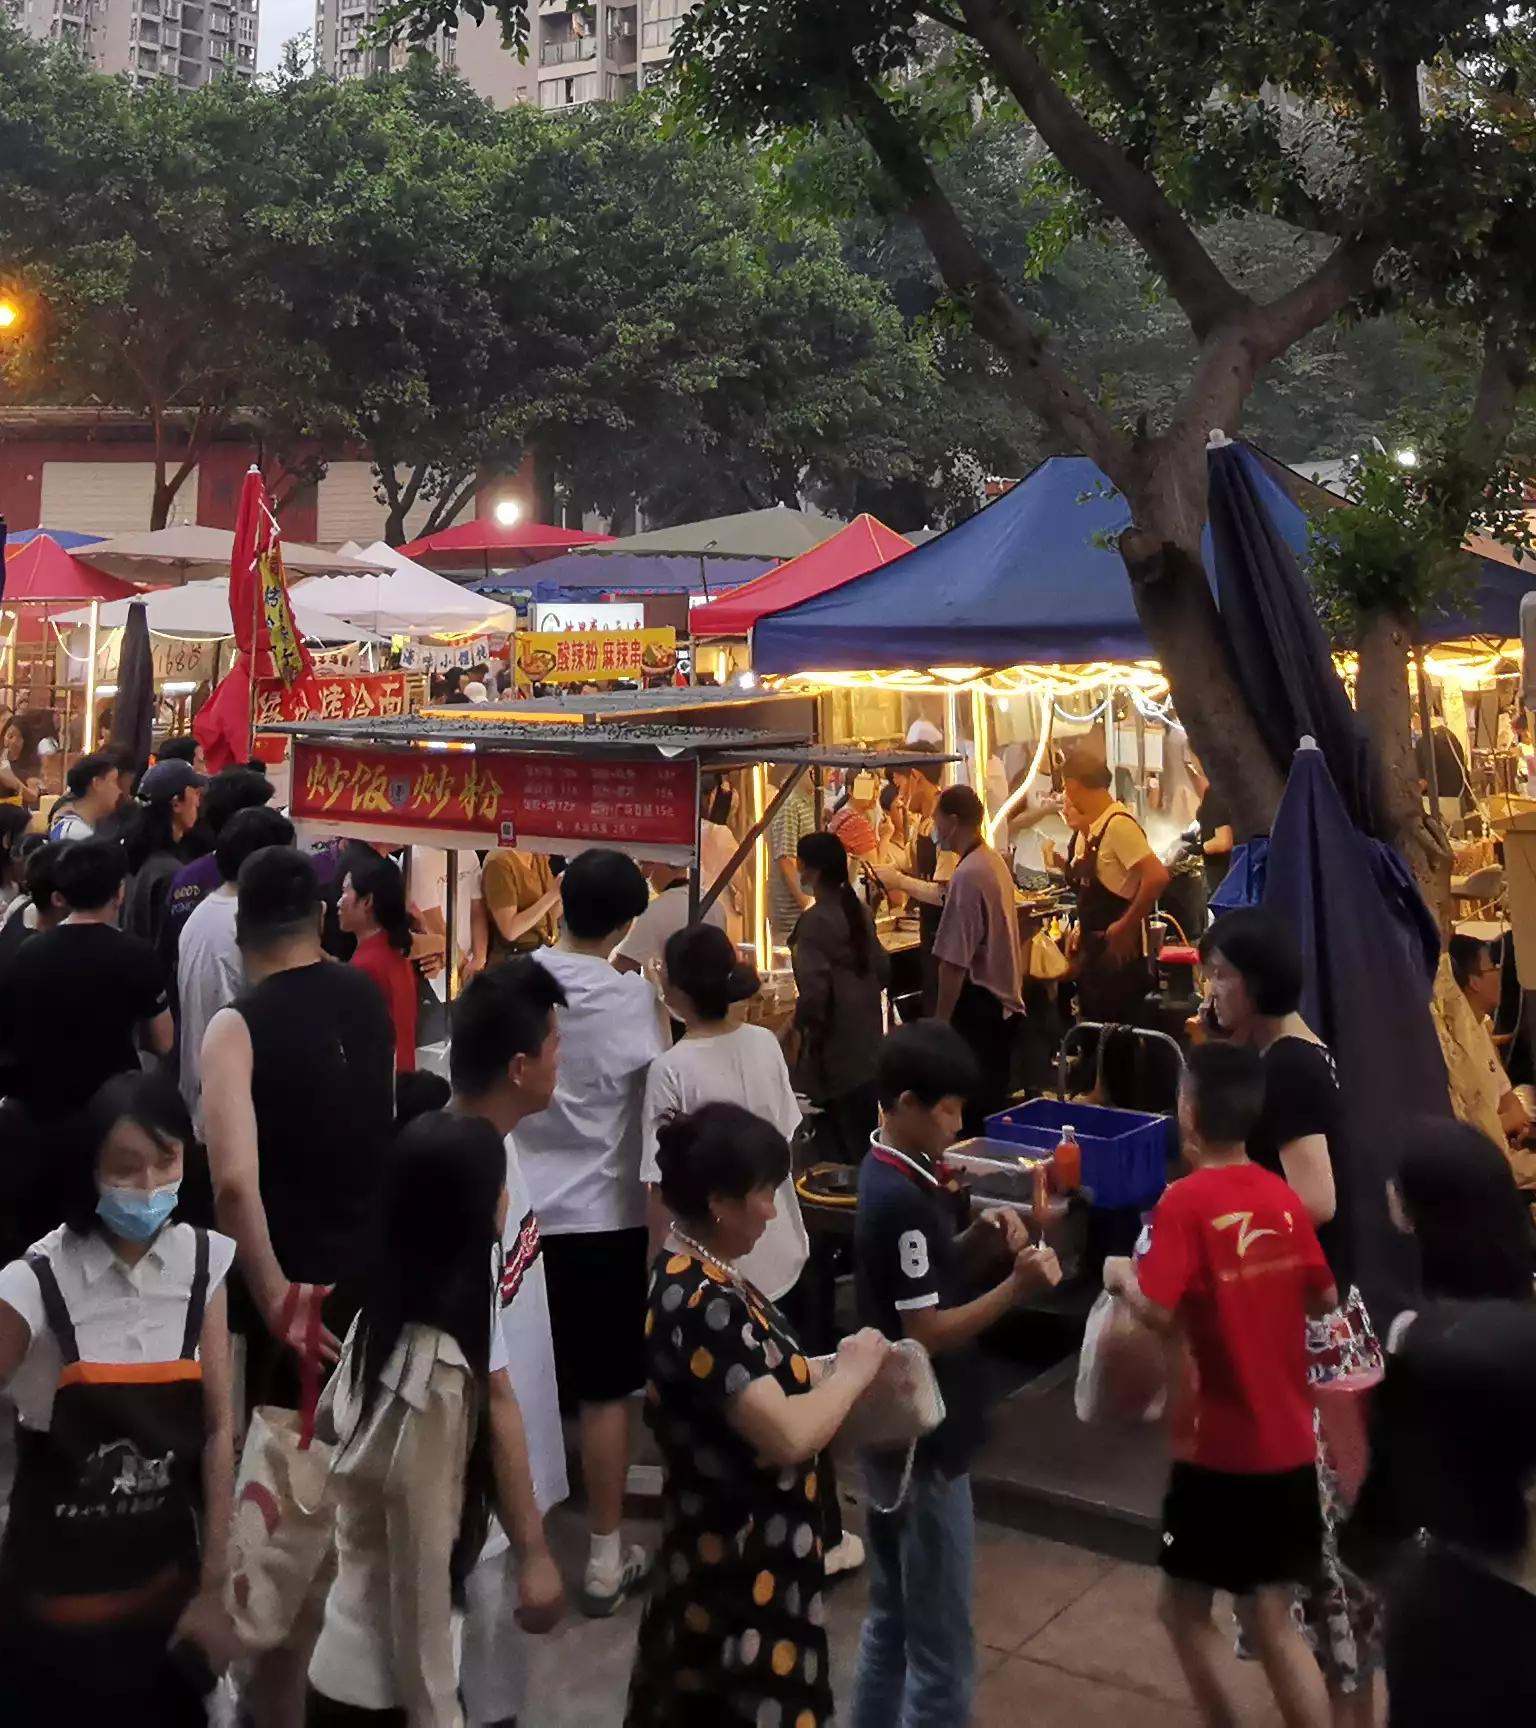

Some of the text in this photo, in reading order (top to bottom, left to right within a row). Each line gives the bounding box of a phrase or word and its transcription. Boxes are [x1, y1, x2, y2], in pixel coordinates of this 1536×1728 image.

[556, 638, 642, 673] 酸辣粉 麻辣串
[306, 753, 503, 820] 炒饭 炒粉
